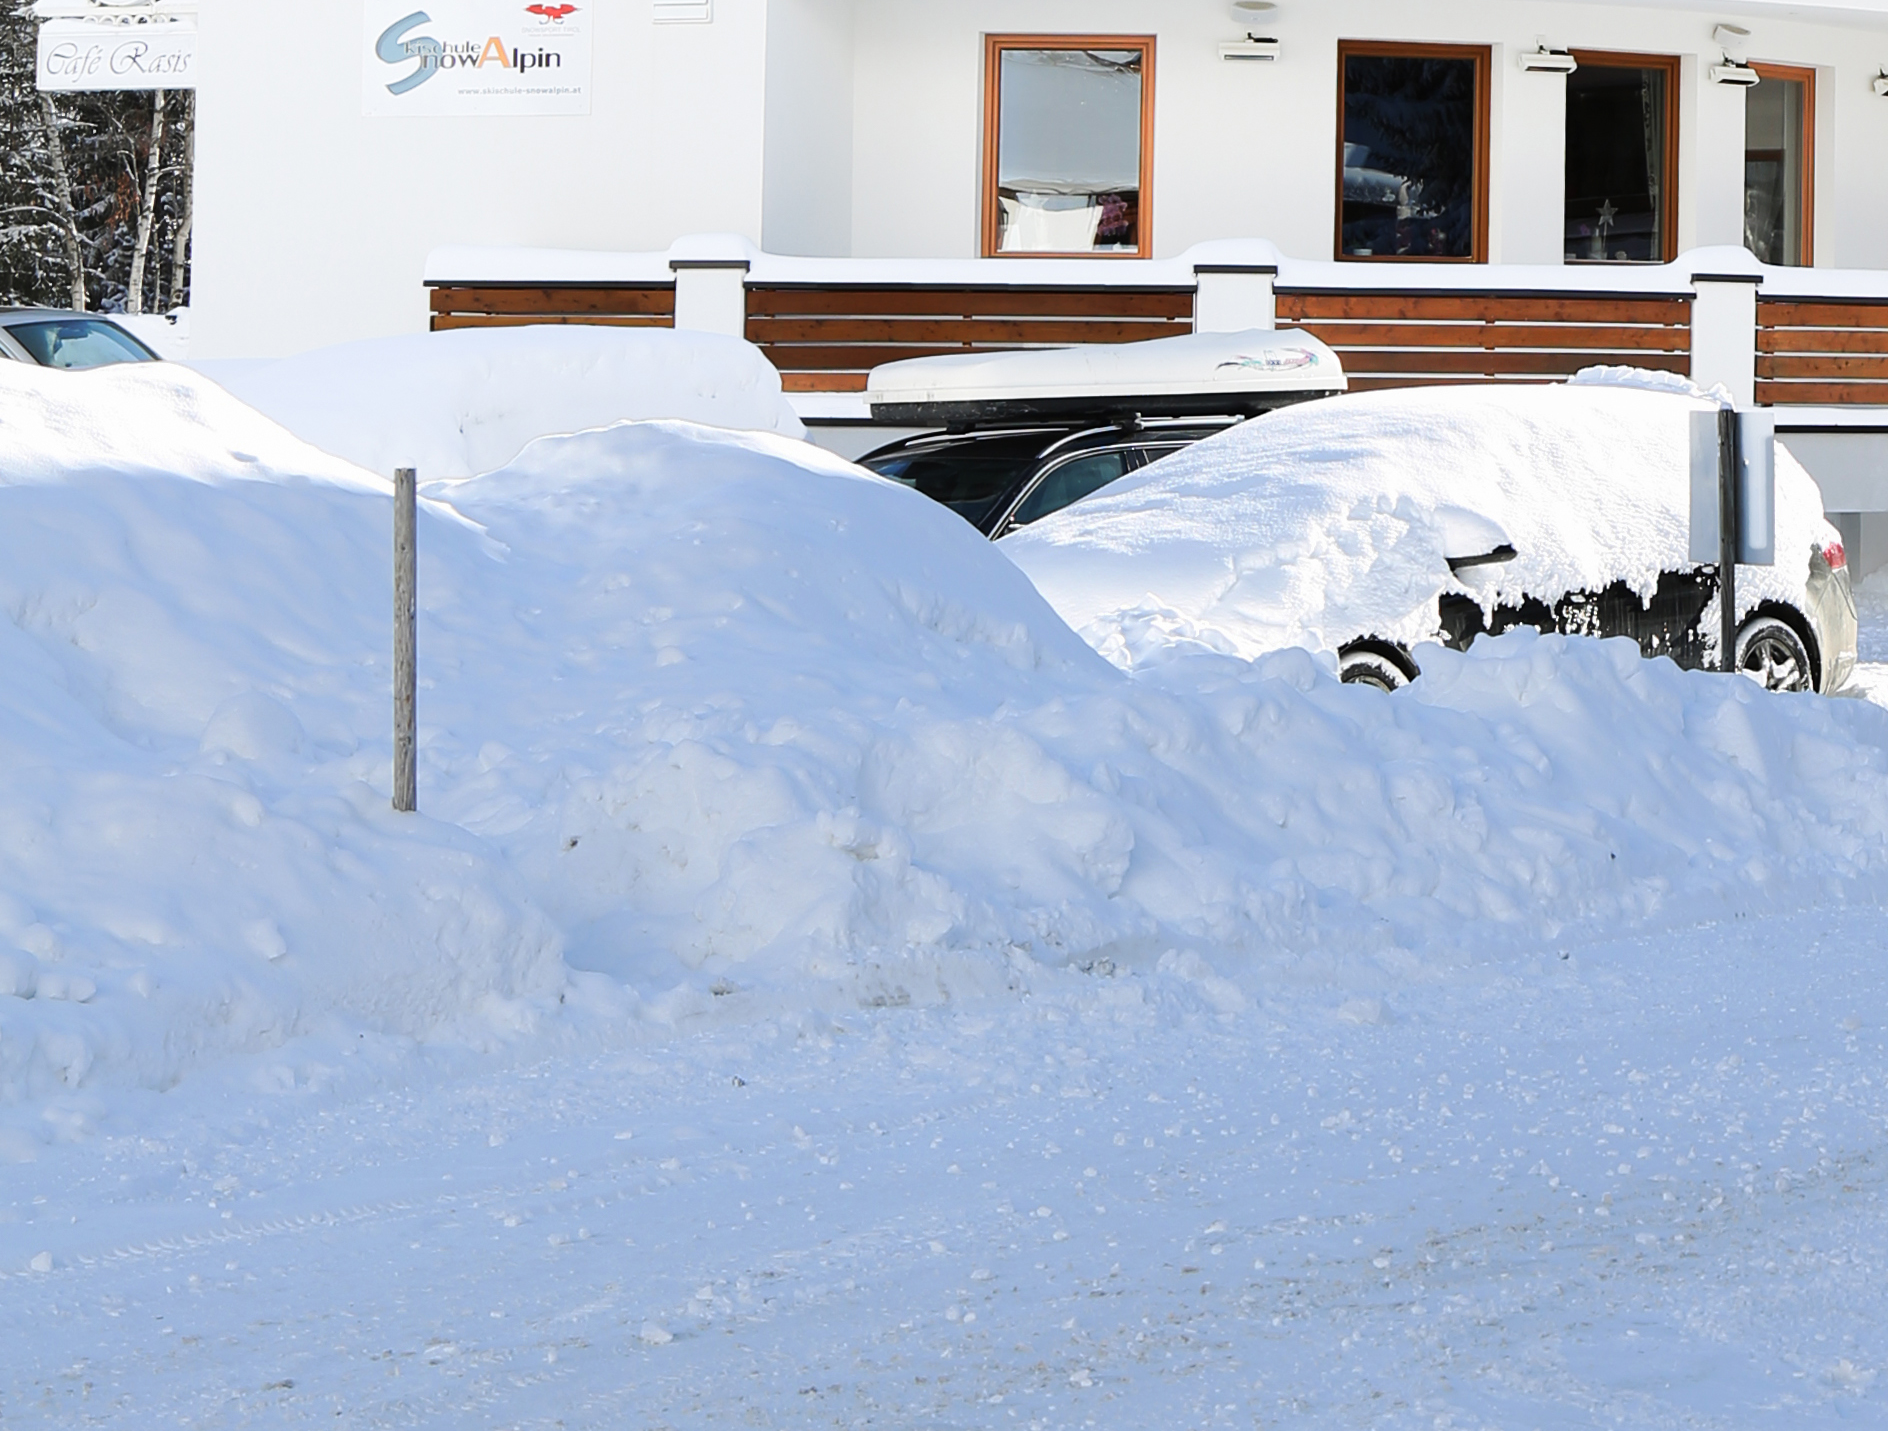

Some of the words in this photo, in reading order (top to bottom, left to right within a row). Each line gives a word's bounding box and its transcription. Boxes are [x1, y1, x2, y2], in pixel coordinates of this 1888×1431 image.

[46, 42, 103, 83] Café
[110, 40, 192, 75] Rasis
[457, 85, 582, 96] www.skischule-snowalpin.at
